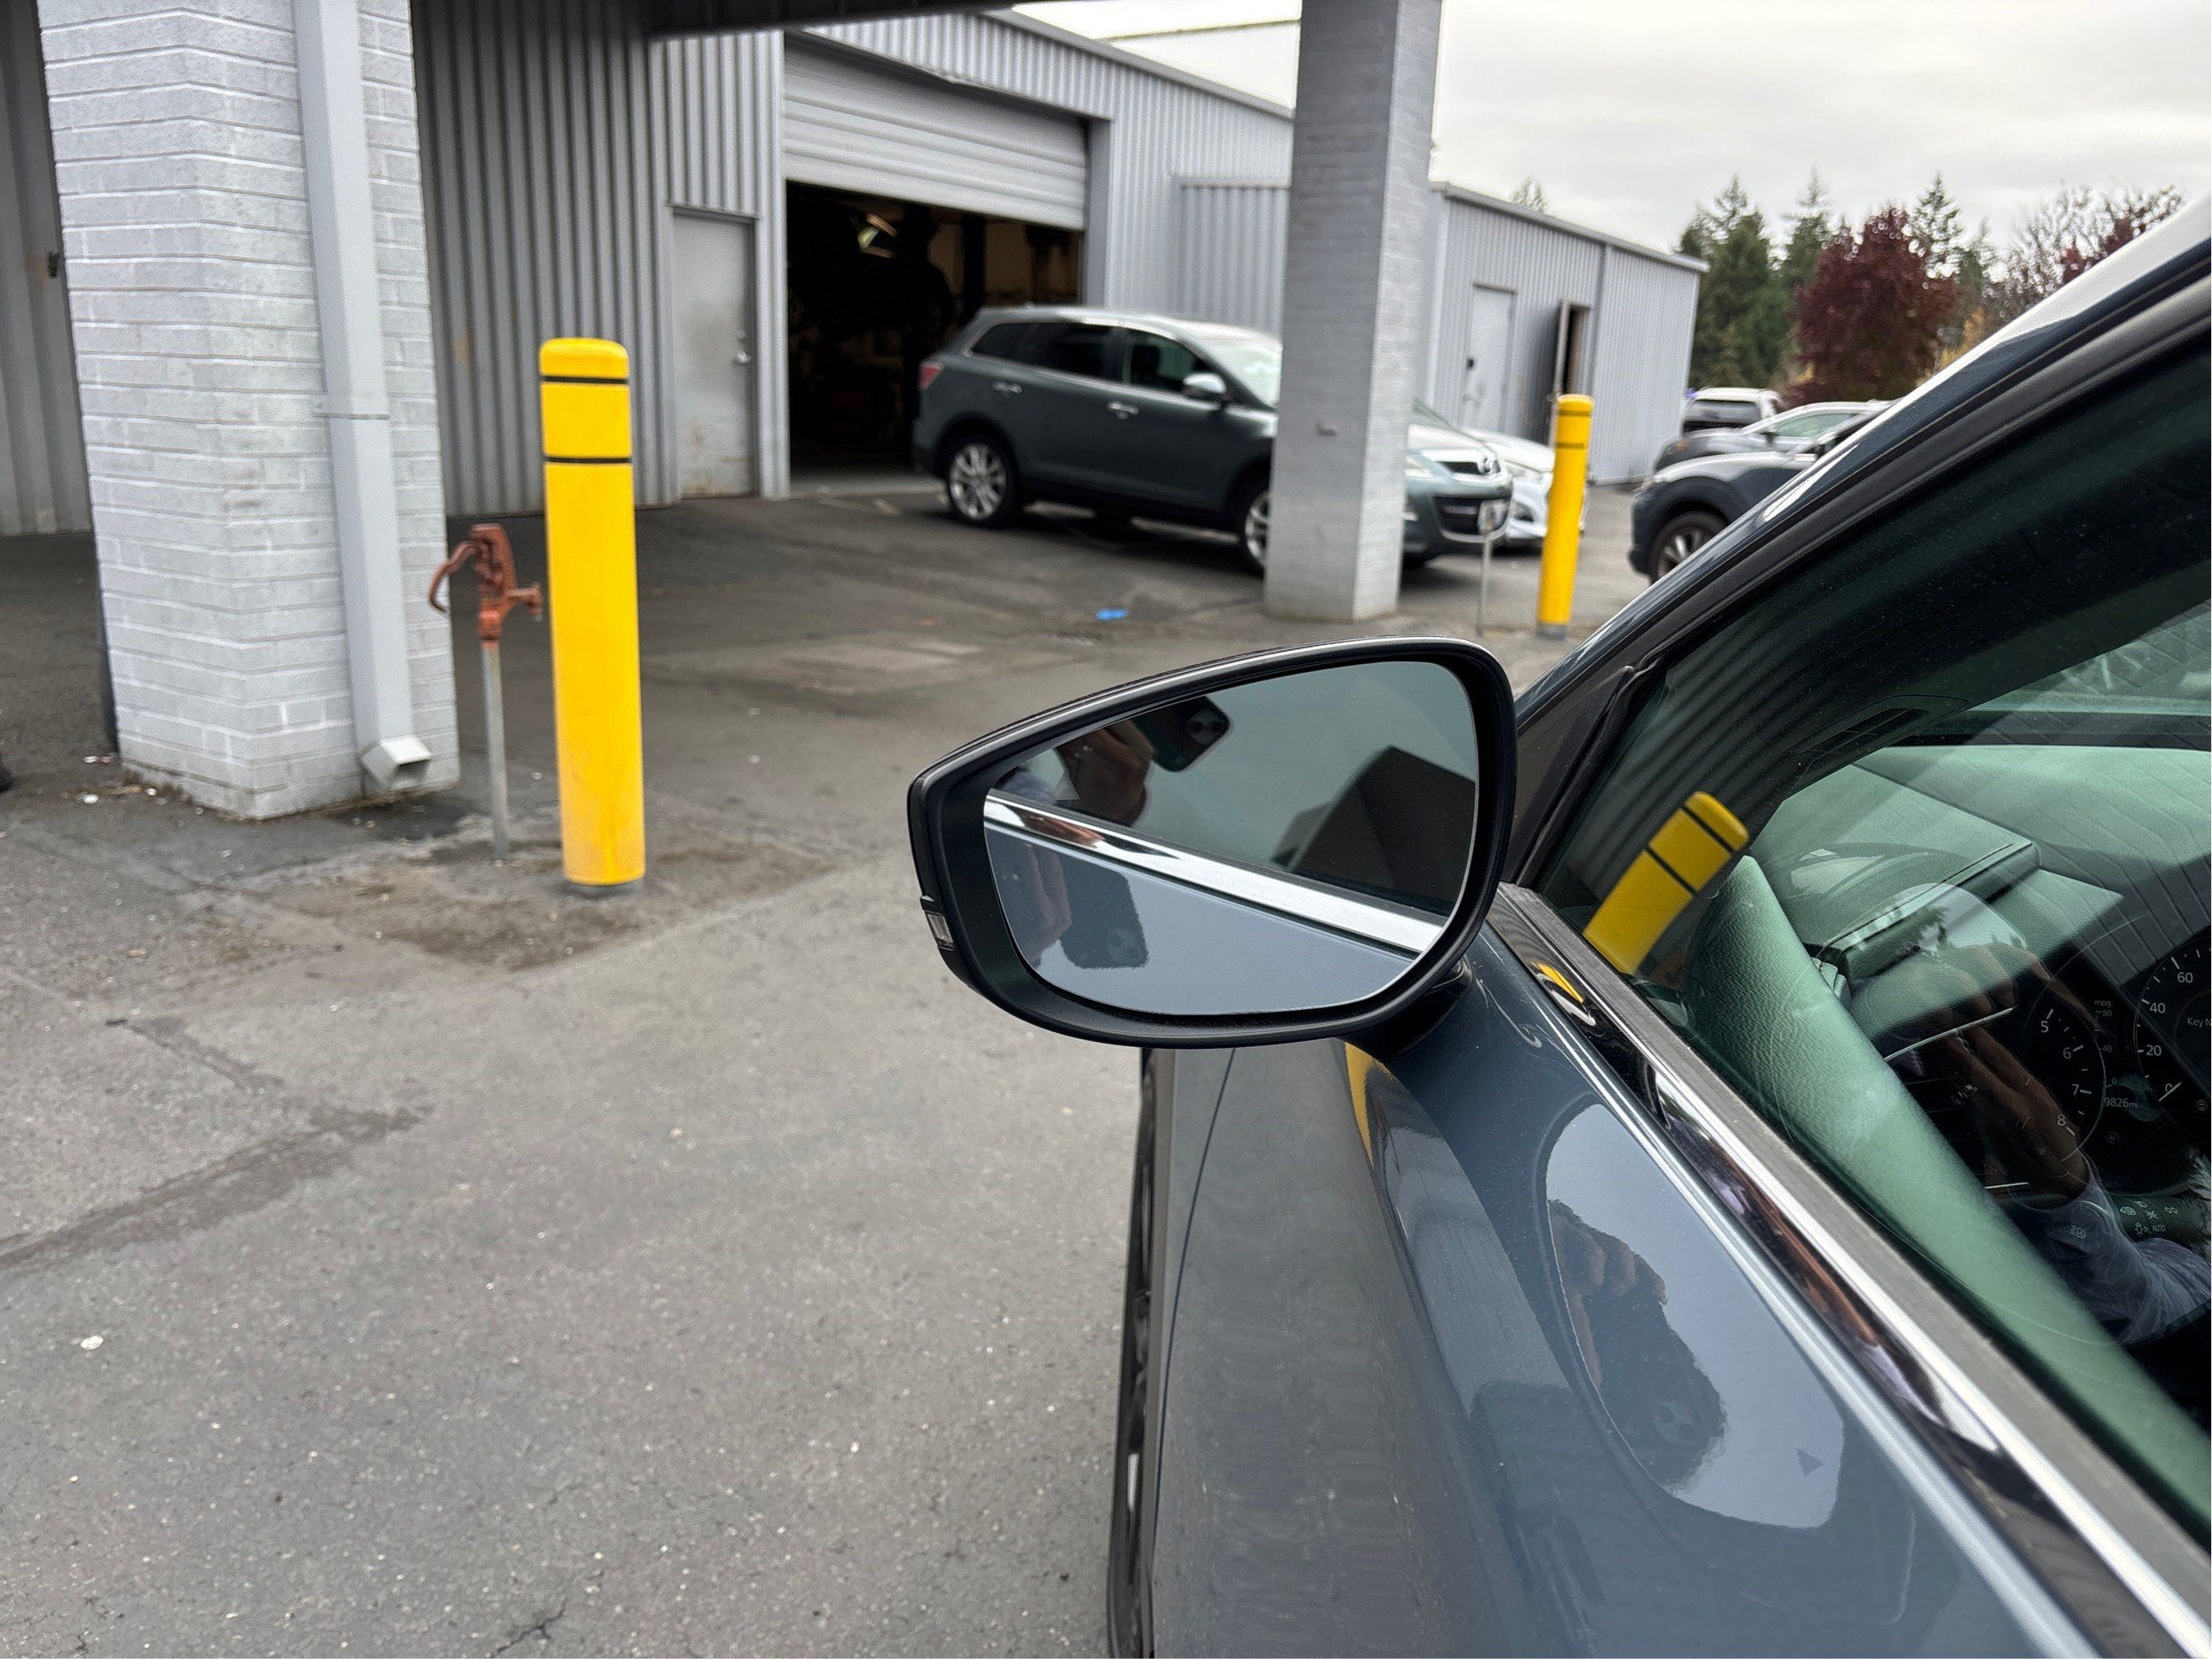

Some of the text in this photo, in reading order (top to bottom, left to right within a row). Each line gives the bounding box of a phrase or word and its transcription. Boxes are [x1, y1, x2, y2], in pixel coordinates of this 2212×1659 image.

[2177, 971, 2193, 983] 60
[2149, 1002, 2166, 1014] 40
[2040, 1020, 2049, 1033] 5
[2187, 1017, 2204, 1029] Key
[2062, 1047, 2072, 1060] 6
[2146, 1045, 2162, 1056] 20
[2071, 1084, 2080, 1096] 7
[2057, 1114, 2066, 1127] 8
